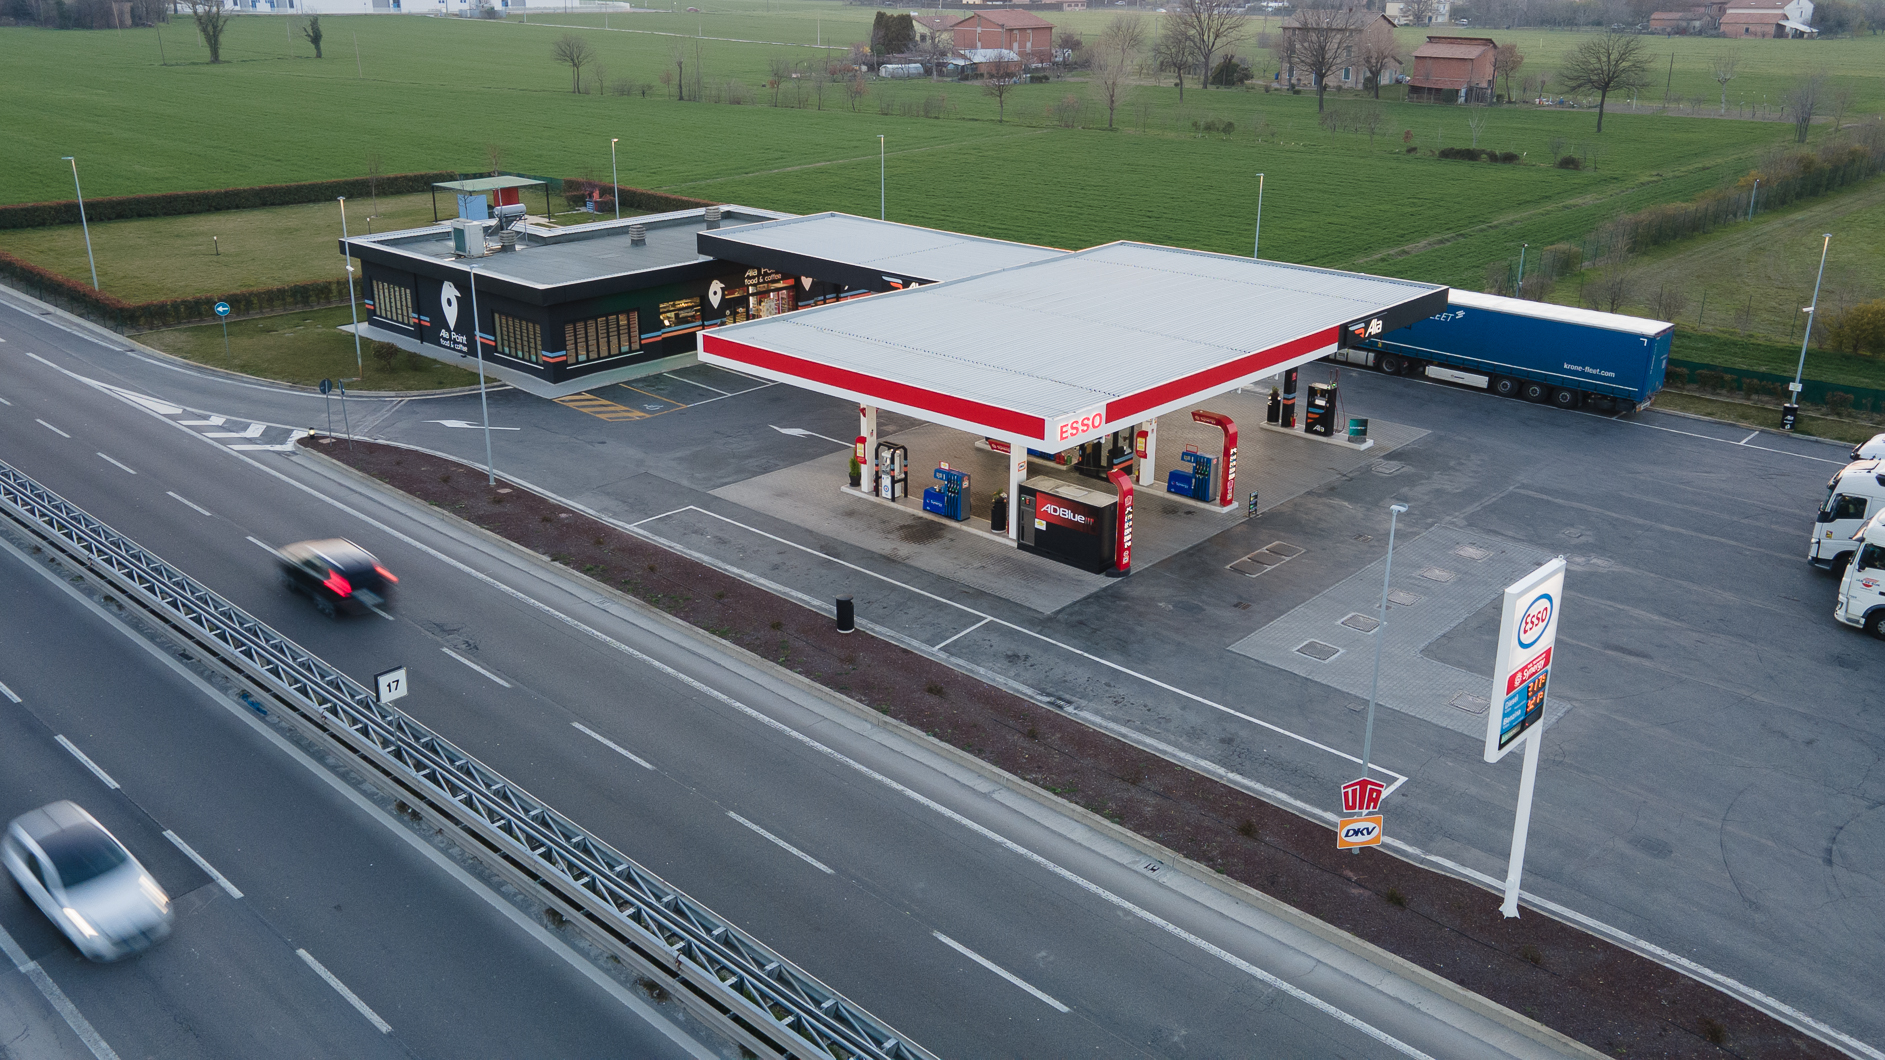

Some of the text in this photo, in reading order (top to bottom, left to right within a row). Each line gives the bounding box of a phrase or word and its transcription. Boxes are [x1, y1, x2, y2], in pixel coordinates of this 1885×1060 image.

[745, 277, 758, 285] food
[765, 273, 781, 281] coffee
[1365, 318, 1383, 338] Ala
[451, 331, 467, 345] Point
[1563, 361, 1616, 378] krone-fleet.com
[1059, 412, 1103, 442] ESSO
[1040, 503, 1085, 524] ADBlue
[387, 679, 400, 693] 17
[1343, 779, 1385, 811] UTA
[1344, 826, 1376, 838] DKV
